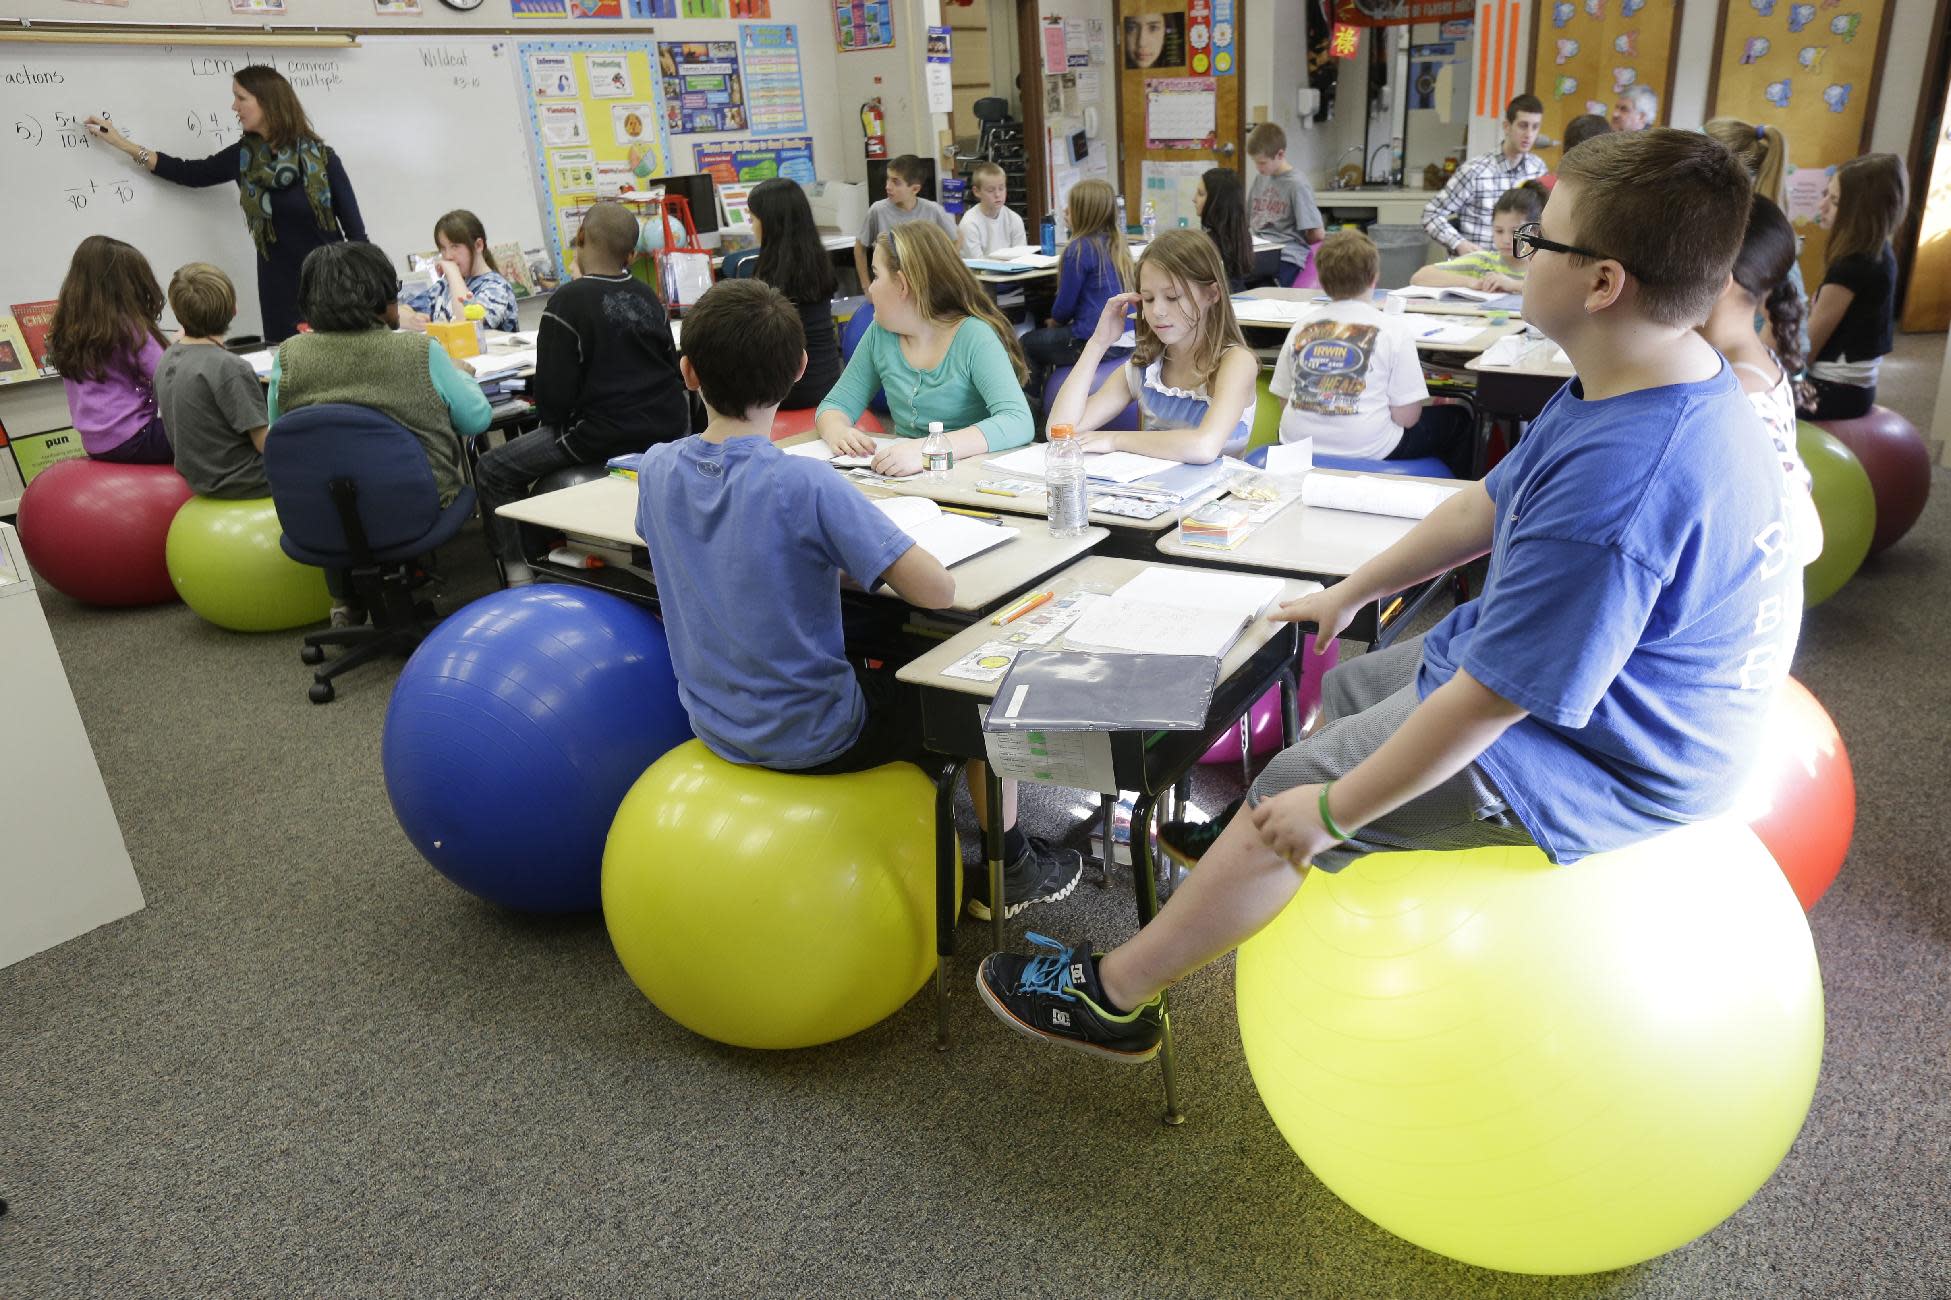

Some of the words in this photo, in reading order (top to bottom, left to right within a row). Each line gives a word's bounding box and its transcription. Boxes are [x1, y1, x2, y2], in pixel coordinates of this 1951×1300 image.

[418, 47, 468, 68] Wildcat
[5, 64, 65, 84] actions
[288, 60, 338, 73] common
[1312, 345, 1348, 358] IRWIN
[45, 435, 69, 448] pun
[1052, 1008, 1071, 1027] DC
